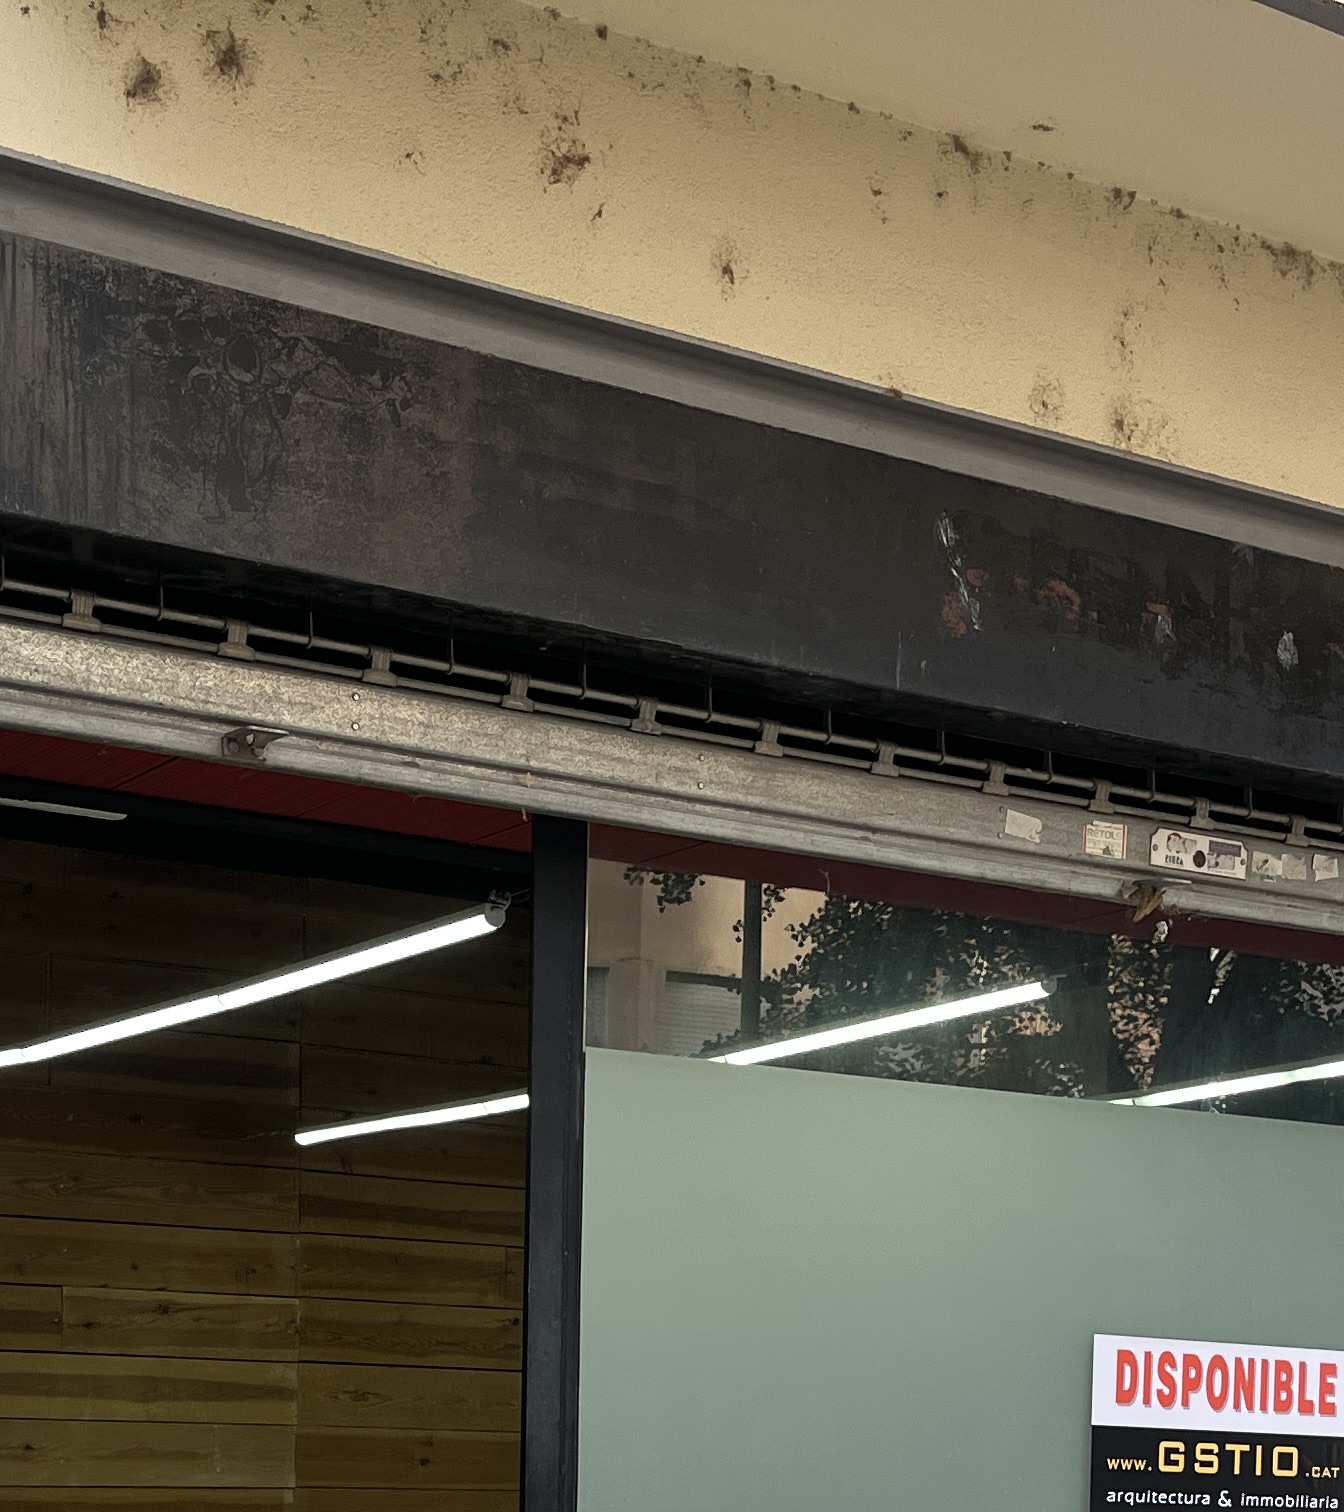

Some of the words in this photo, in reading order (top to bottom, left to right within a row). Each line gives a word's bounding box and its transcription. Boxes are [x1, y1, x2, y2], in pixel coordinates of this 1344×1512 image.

[1115, 1348, 1338, 1417] DISPONIBLE
[1106, 1488, 1210, 1507] arquitectura
[1217, 1490, 1232, 1508] &
[1240, 1491, 1339, 1510] immobiliaria
